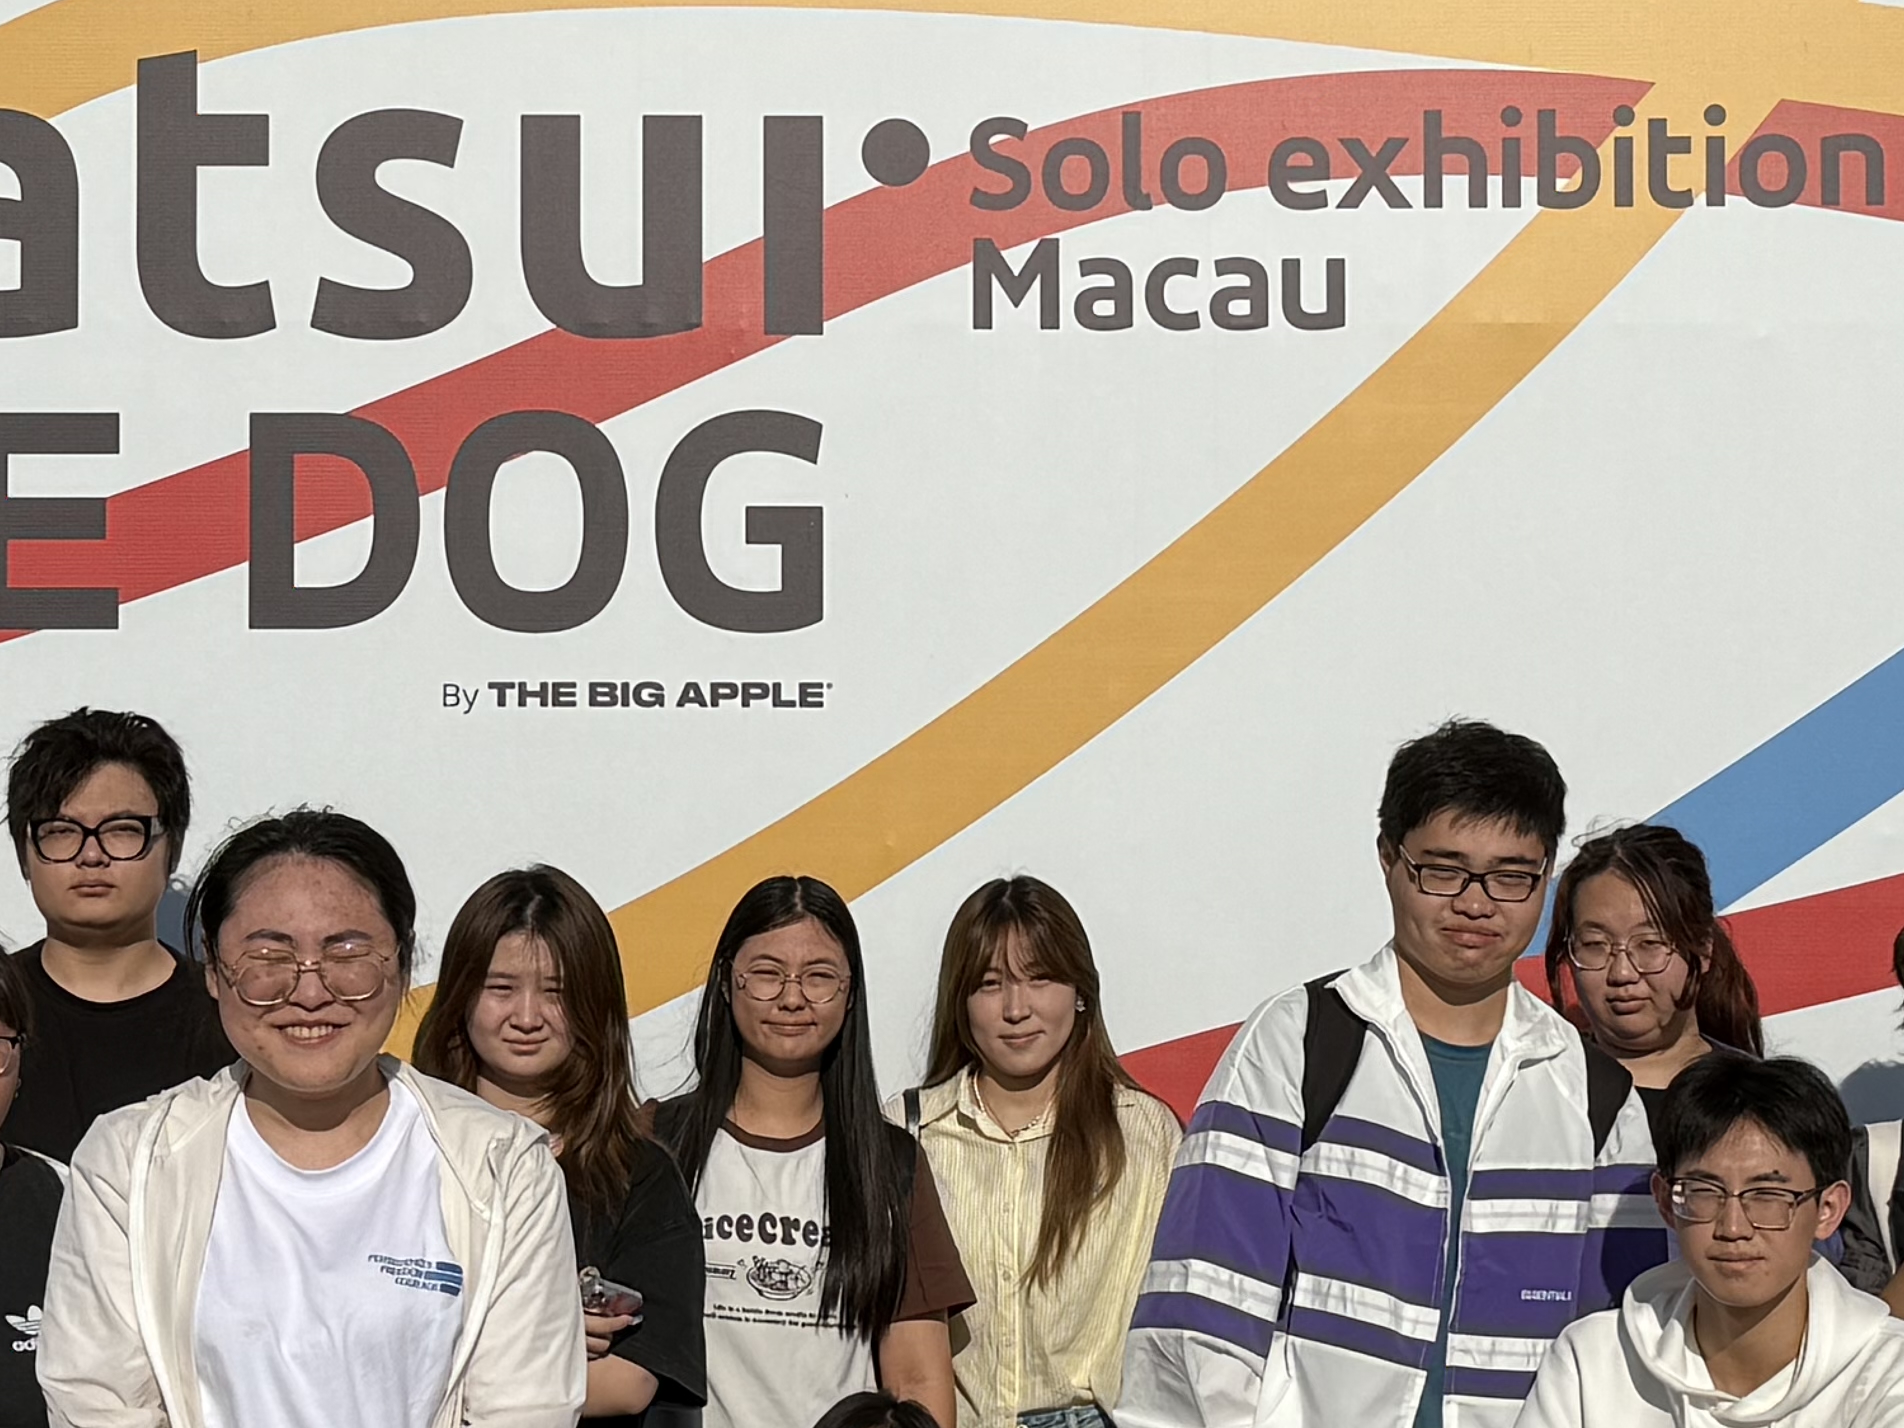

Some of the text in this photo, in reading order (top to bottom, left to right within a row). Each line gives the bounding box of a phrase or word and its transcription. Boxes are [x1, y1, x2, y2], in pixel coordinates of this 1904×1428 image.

[968, 103, 1886, 212] Solo exhibition
[970, 236, 1347, 333] Macau
[247, 408, 825, 635] DOG
[442, 681, 826, 715] By THE BIG APPLE
